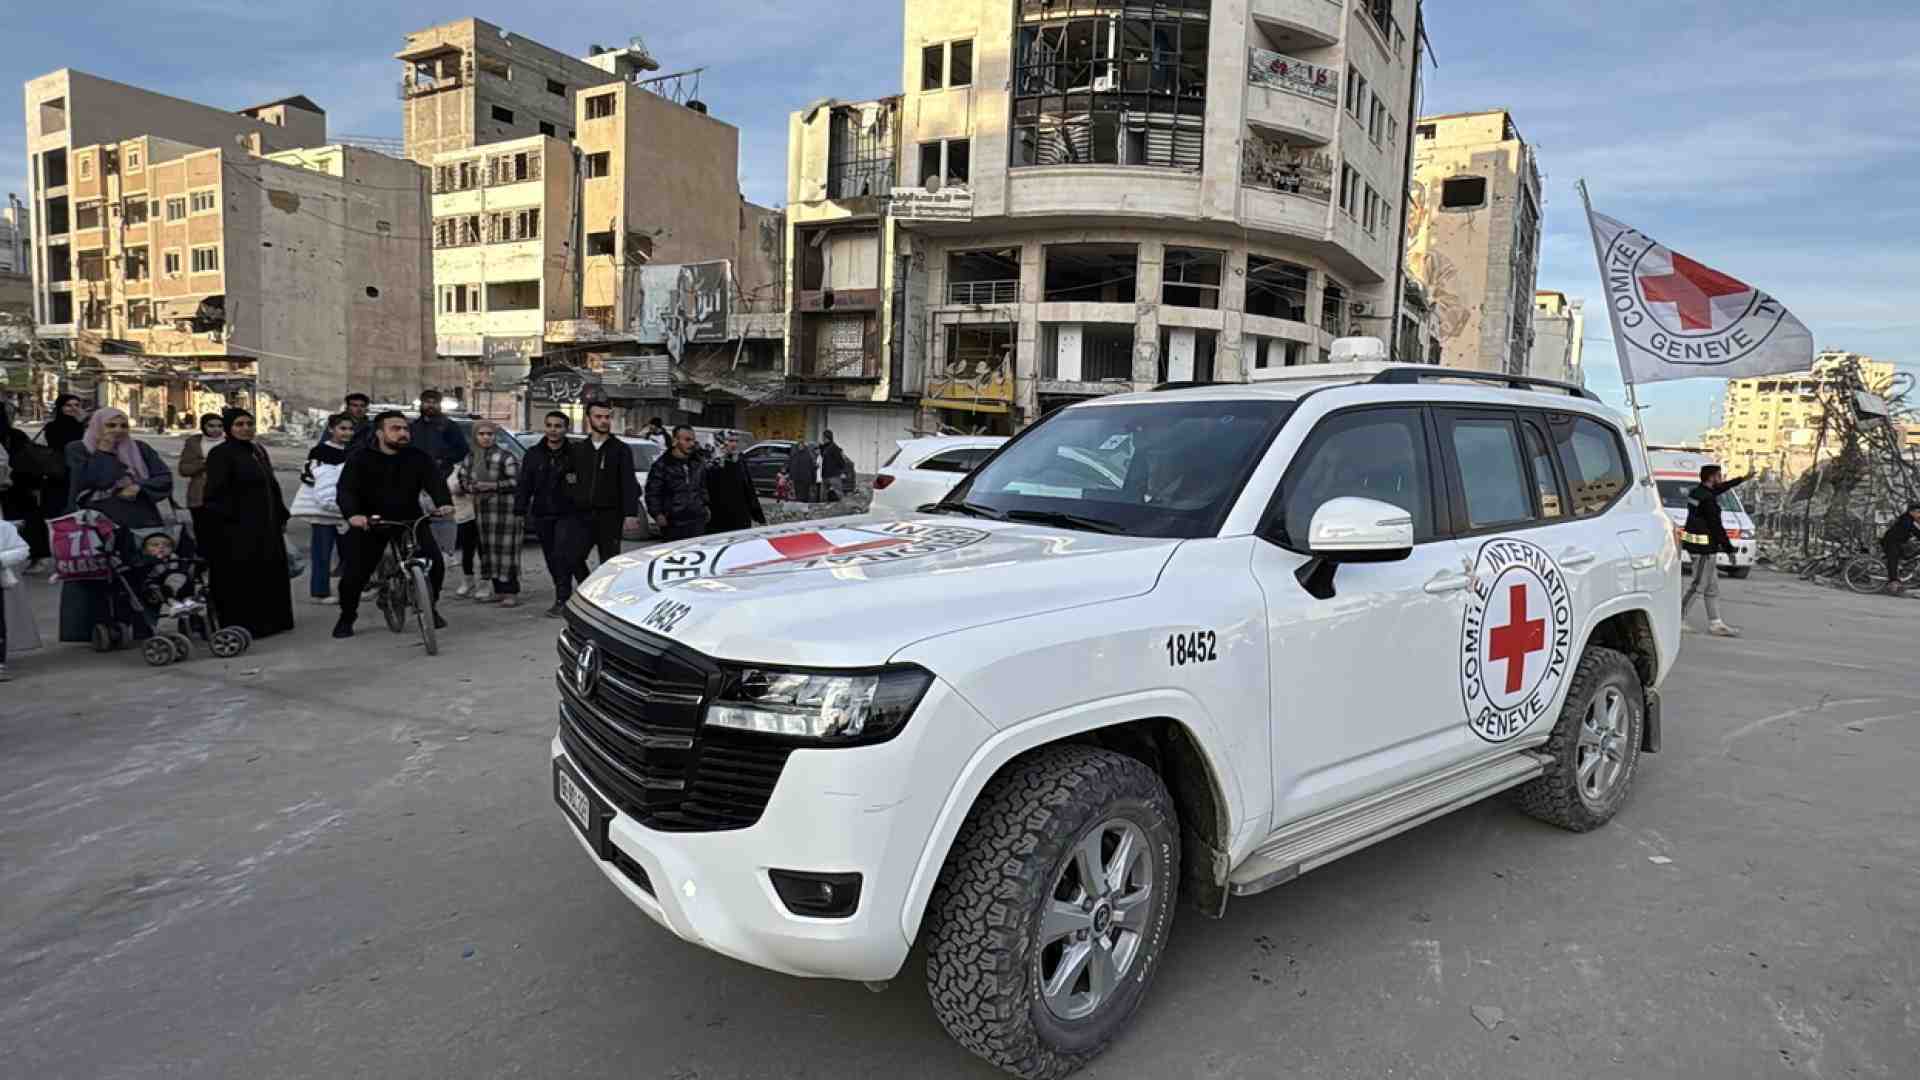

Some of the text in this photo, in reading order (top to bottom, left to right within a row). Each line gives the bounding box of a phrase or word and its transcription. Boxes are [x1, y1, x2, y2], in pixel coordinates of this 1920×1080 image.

[1611, 244, 1644, 328] COMITE
[1650, 328, 1753, 359] GENEVE
[1485, 542, 1569, 680] INTERNATIONAL
[1166, 630, 1217, 667] 18452
[1476, 692, 1545, 737] GENEVE
